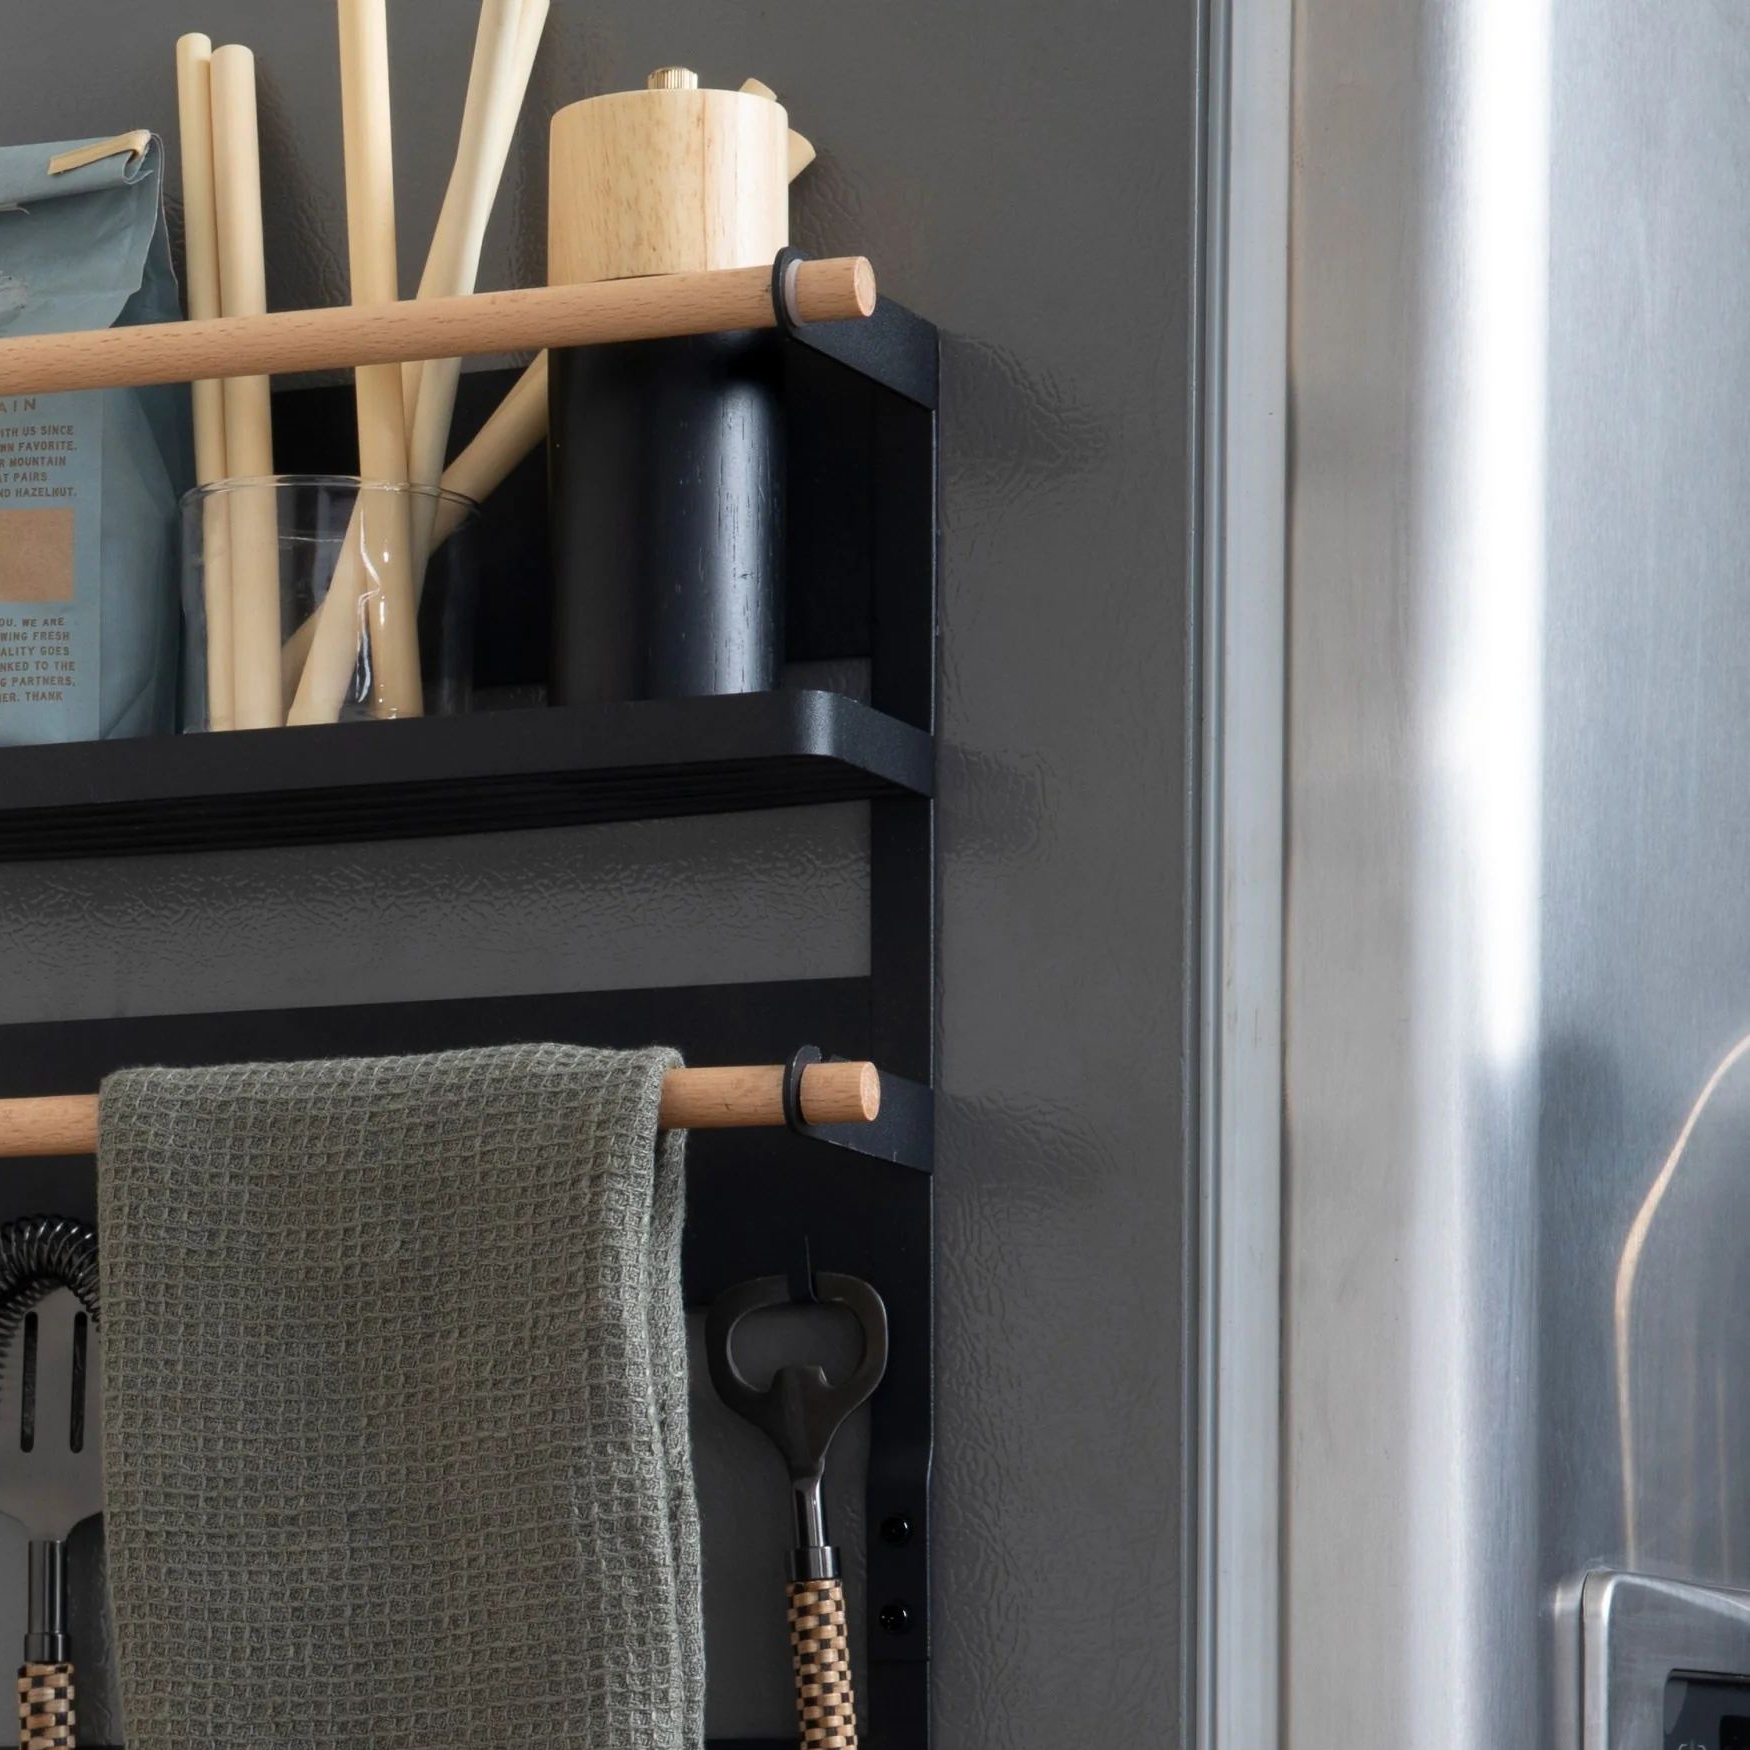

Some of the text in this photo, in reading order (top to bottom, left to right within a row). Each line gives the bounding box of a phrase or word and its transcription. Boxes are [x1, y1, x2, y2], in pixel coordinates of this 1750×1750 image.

[22, 426, 36, 436] US
[40, 425, 74, 436] SINCE
[9, 456, 66, 467] MOUNTAIN
[13, 472, 48, 482] PAIRS
[21, 618, 37, 627] WE
[42, 617, 65, 626] ARE
[32, 631, 70, 641] FRESH
[40, 646, 70, 656] GOES
[34, 661, 49, 671] TO
[54, 661, 76, 671] THE
[25, 691, 64, 702] THANK
